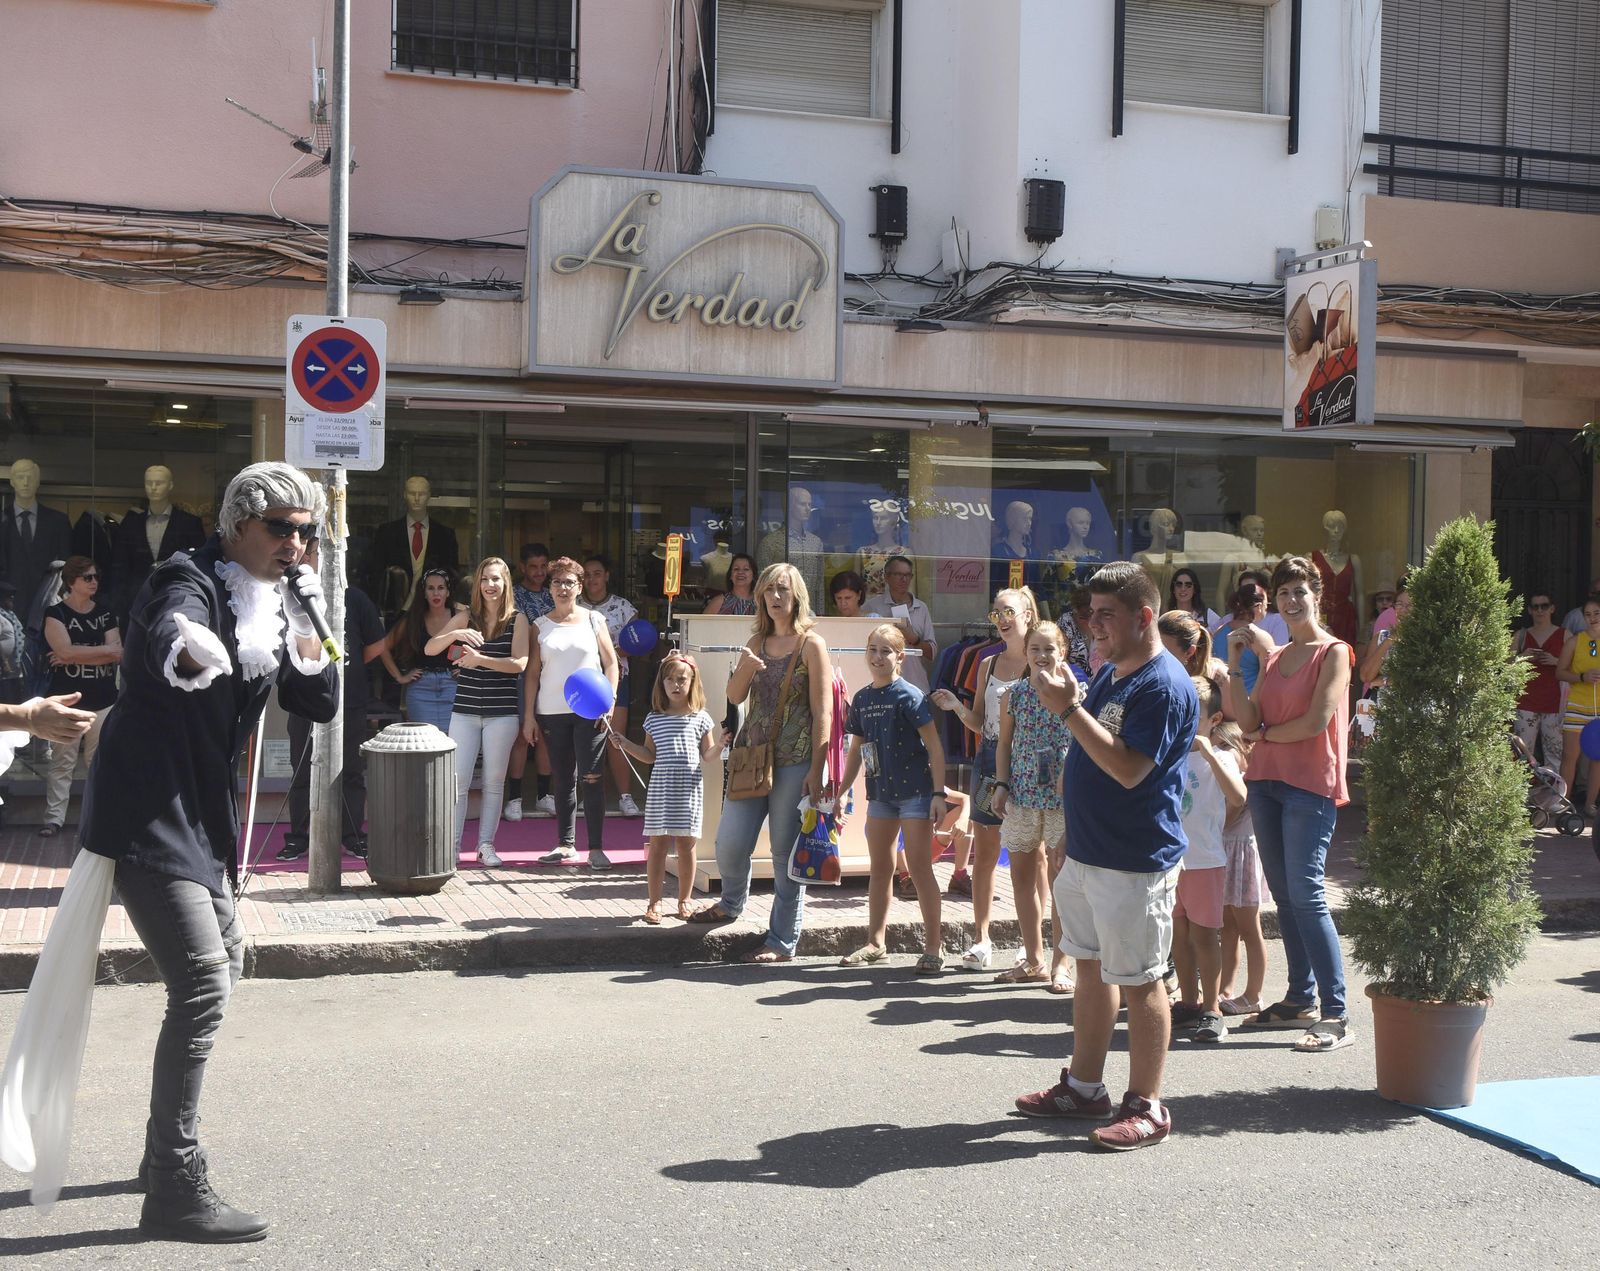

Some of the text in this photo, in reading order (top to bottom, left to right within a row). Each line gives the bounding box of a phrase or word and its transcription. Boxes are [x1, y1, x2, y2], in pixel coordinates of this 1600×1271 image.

[552, 190, 661, 274] La
[604, 223, 829, 360] Verdad
[1309, 391, 1323, 415] La
[1318, 374, 1356, 426] Verdad
